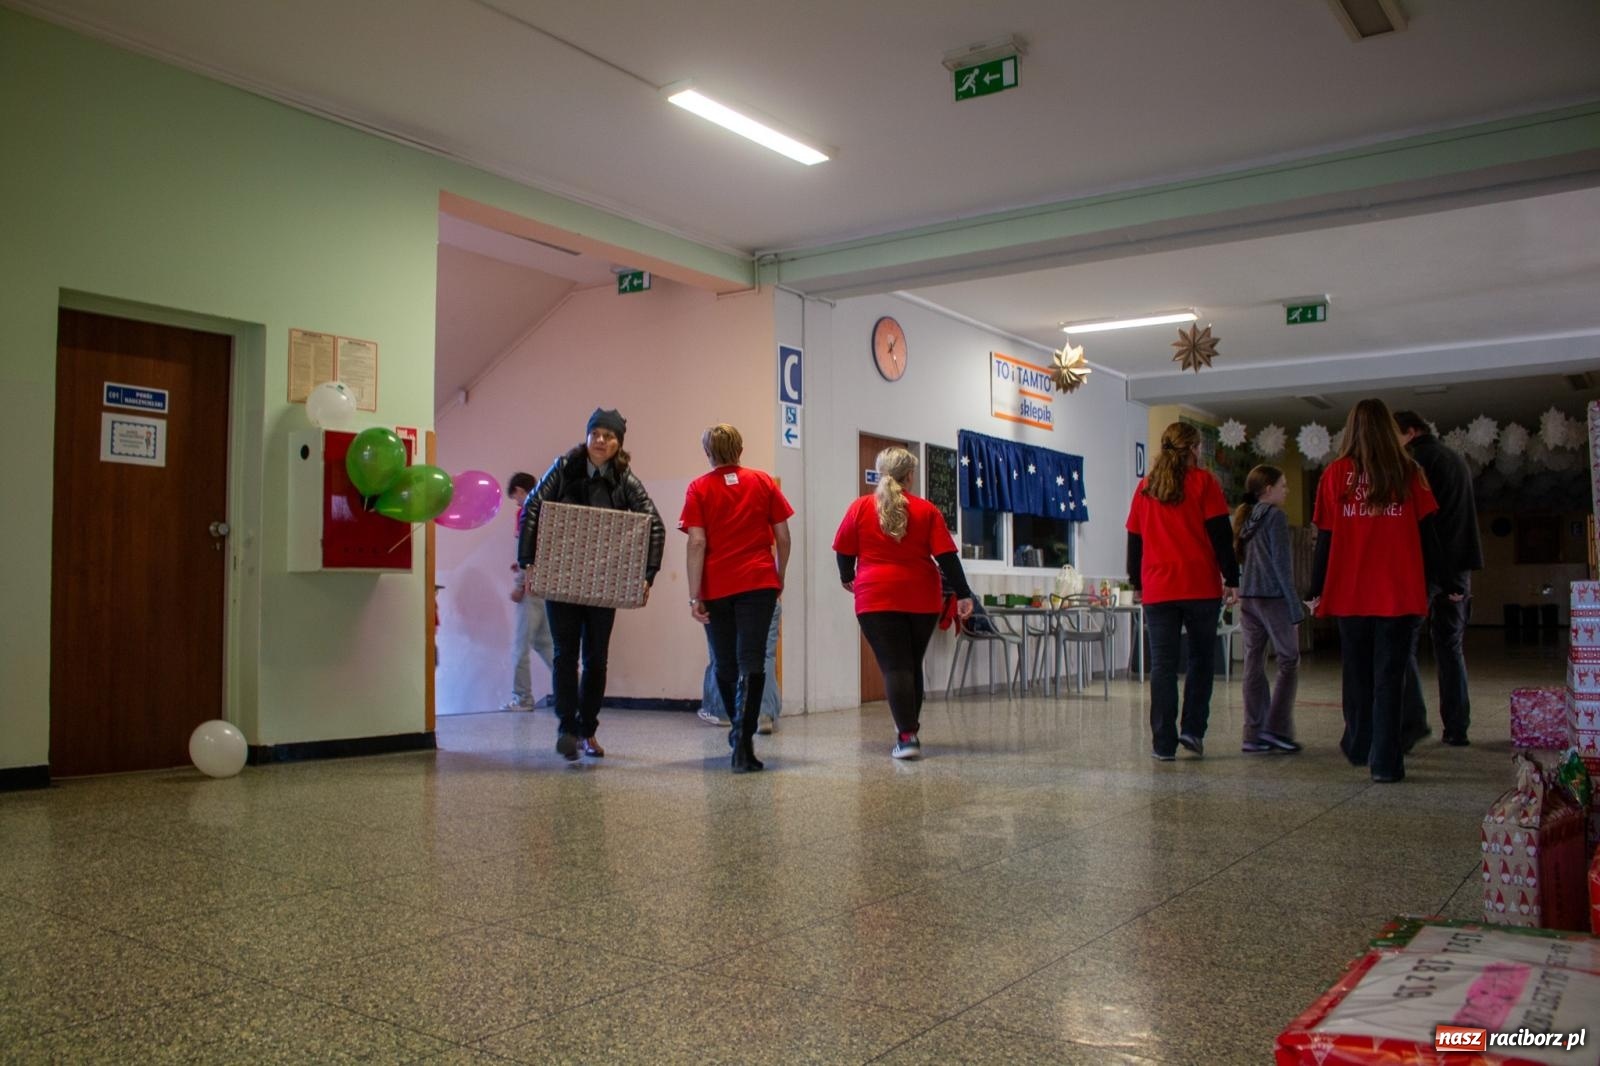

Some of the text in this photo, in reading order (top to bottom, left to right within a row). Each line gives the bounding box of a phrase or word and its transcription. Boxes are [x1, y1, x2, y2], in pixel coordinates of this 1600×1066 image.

[784, 354, 799, 400] C
[995, 359, 1052, 392] TO i TAMTO
[1020, 398, 1052, 422] sklepik
[1137, 446, 1144, 476] D
[1343, 503, 1356, 517] NA
